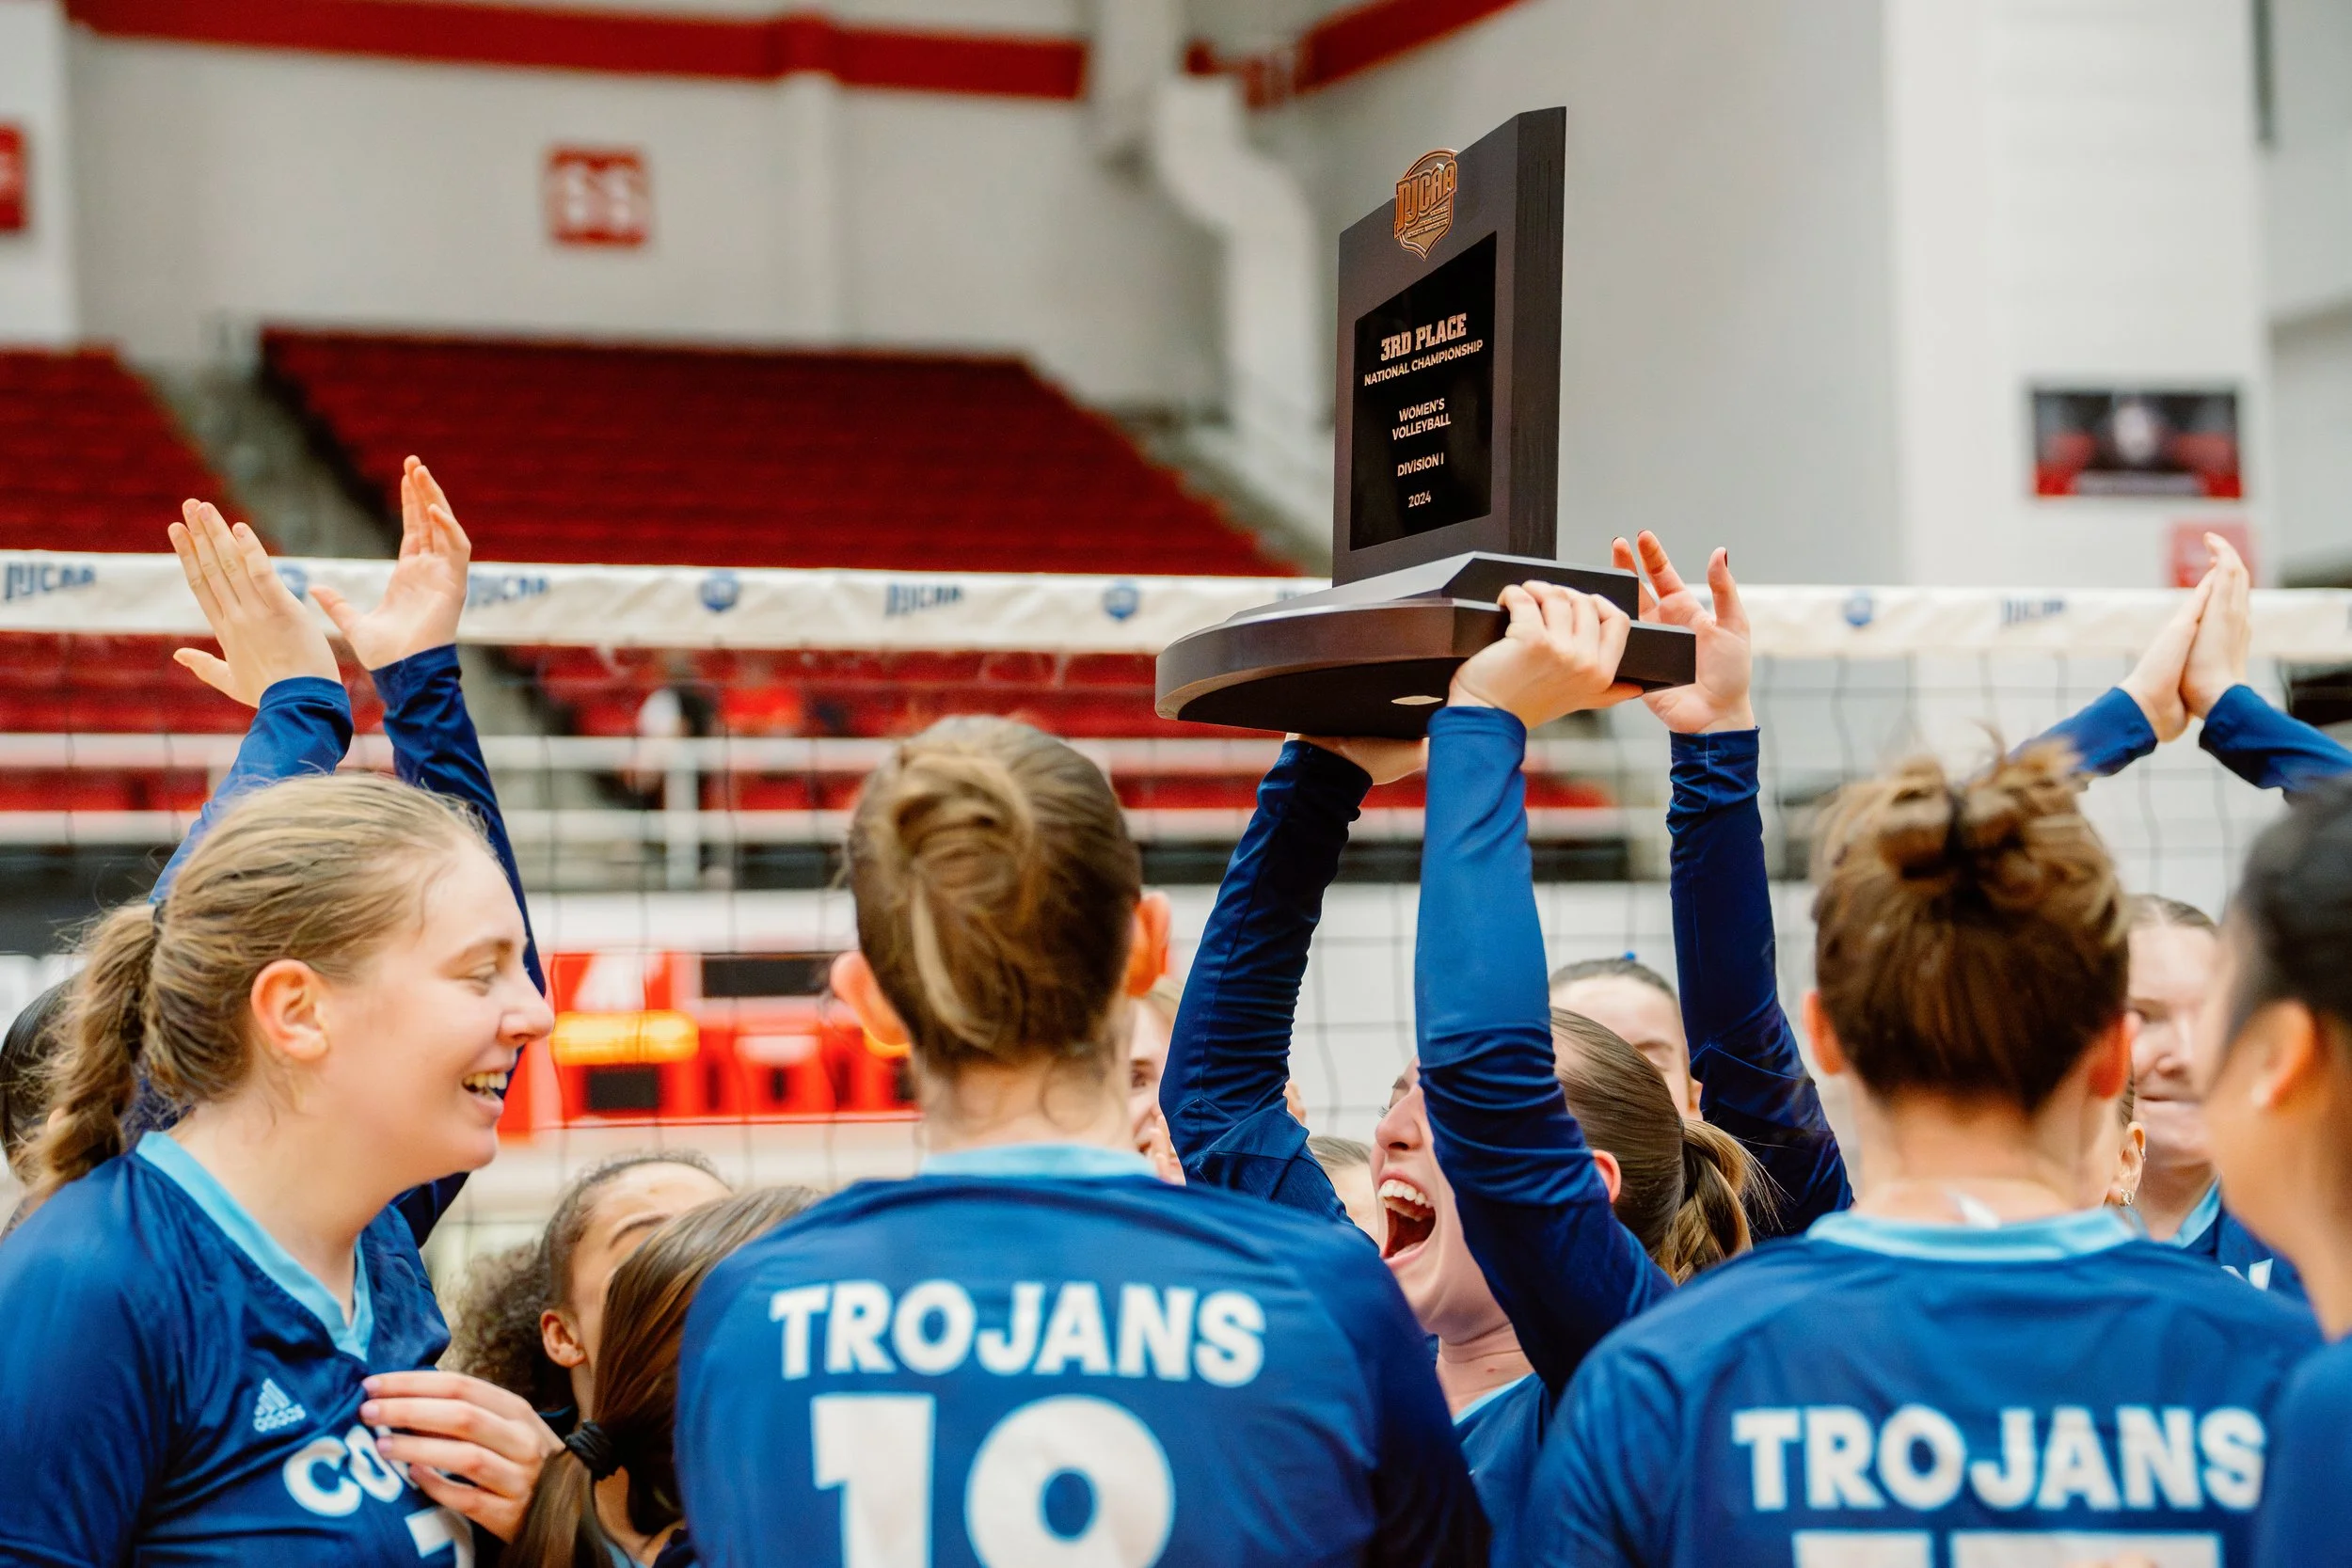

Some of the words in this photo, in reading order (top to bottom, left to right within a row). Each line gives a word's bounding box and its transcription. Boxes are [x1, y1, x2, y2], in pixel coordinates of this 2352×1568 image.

[1395, 161, 1456, 232] NJCAA
[1380, 331, 1411, 361] 3RD
[1415, 312, 1467, 351] PLACE
[1363, 362, 1410, 387] NATIONAL
[1411, 339, 1484, 372] CHAMPIONSHIP
[1391, 413, 1452, 441] VOLLEYBALL
[1398, 397, 1445, 422] WOMEN'S
[1397, 452, 1439, 477] DIVISION
[1407, 490, 1432, 508] 2024
[5, 562, 97, 602] NJCAA
[770, 1279, 1266, 1388] TROJANS
[253, 1403, 306, 1433] adidas
[1731, 1403, 2267, 1512] TROJANS
